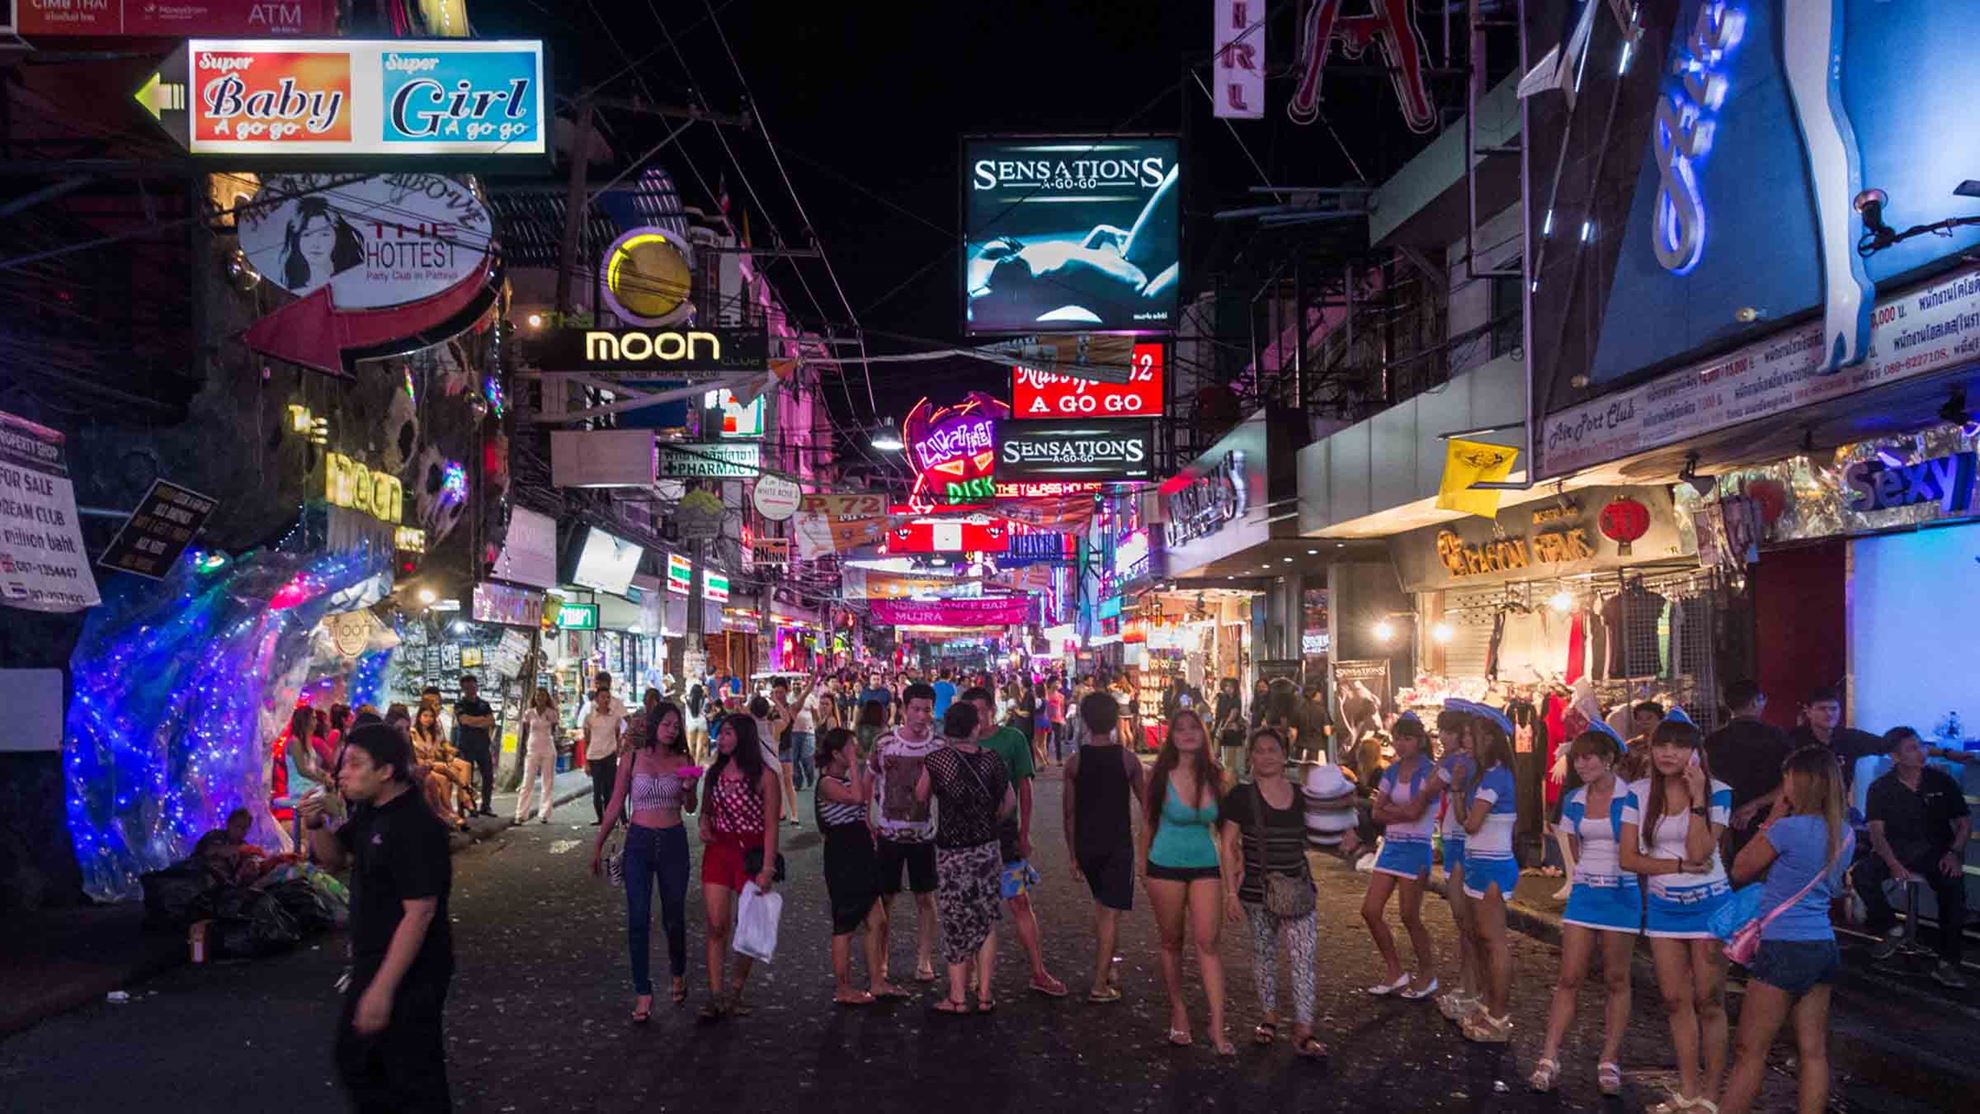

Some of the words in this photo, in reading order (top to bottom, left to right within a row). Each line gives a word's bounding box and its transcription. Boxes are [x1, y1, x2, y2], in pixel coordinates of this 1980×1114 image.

[249, 3, 301, 25] ATM
[199, 53, 254, 71] Super
[385, 53, 440, 71] Super
[204, 73, 343, 134] Baby
[390, 77, 529, 137] Girl
[214, 119, 230, 135] A
[445, 120, 459, 136] A
[366, 221, 458, 239] THE
[366, 241, 458, 269] HOTTEST
[366, 270, 389, 282] Party
[392, 270, 412, 280] Club
[586, 331, 720, 361] moon
[1029, 396, 1050, 413] A
[1059, 394, 1097, 412] GO
[1104, 393, 1143, 412] GO
[1606, 399, 1637, 429] Club
[24, 473, 54, 496] SALE
[36, 506, 65, 526] CLUB
[4, 528, 45, 549] million
[46, 532, 77, 553] baht
[981, 600, 1008, 609] BAR
